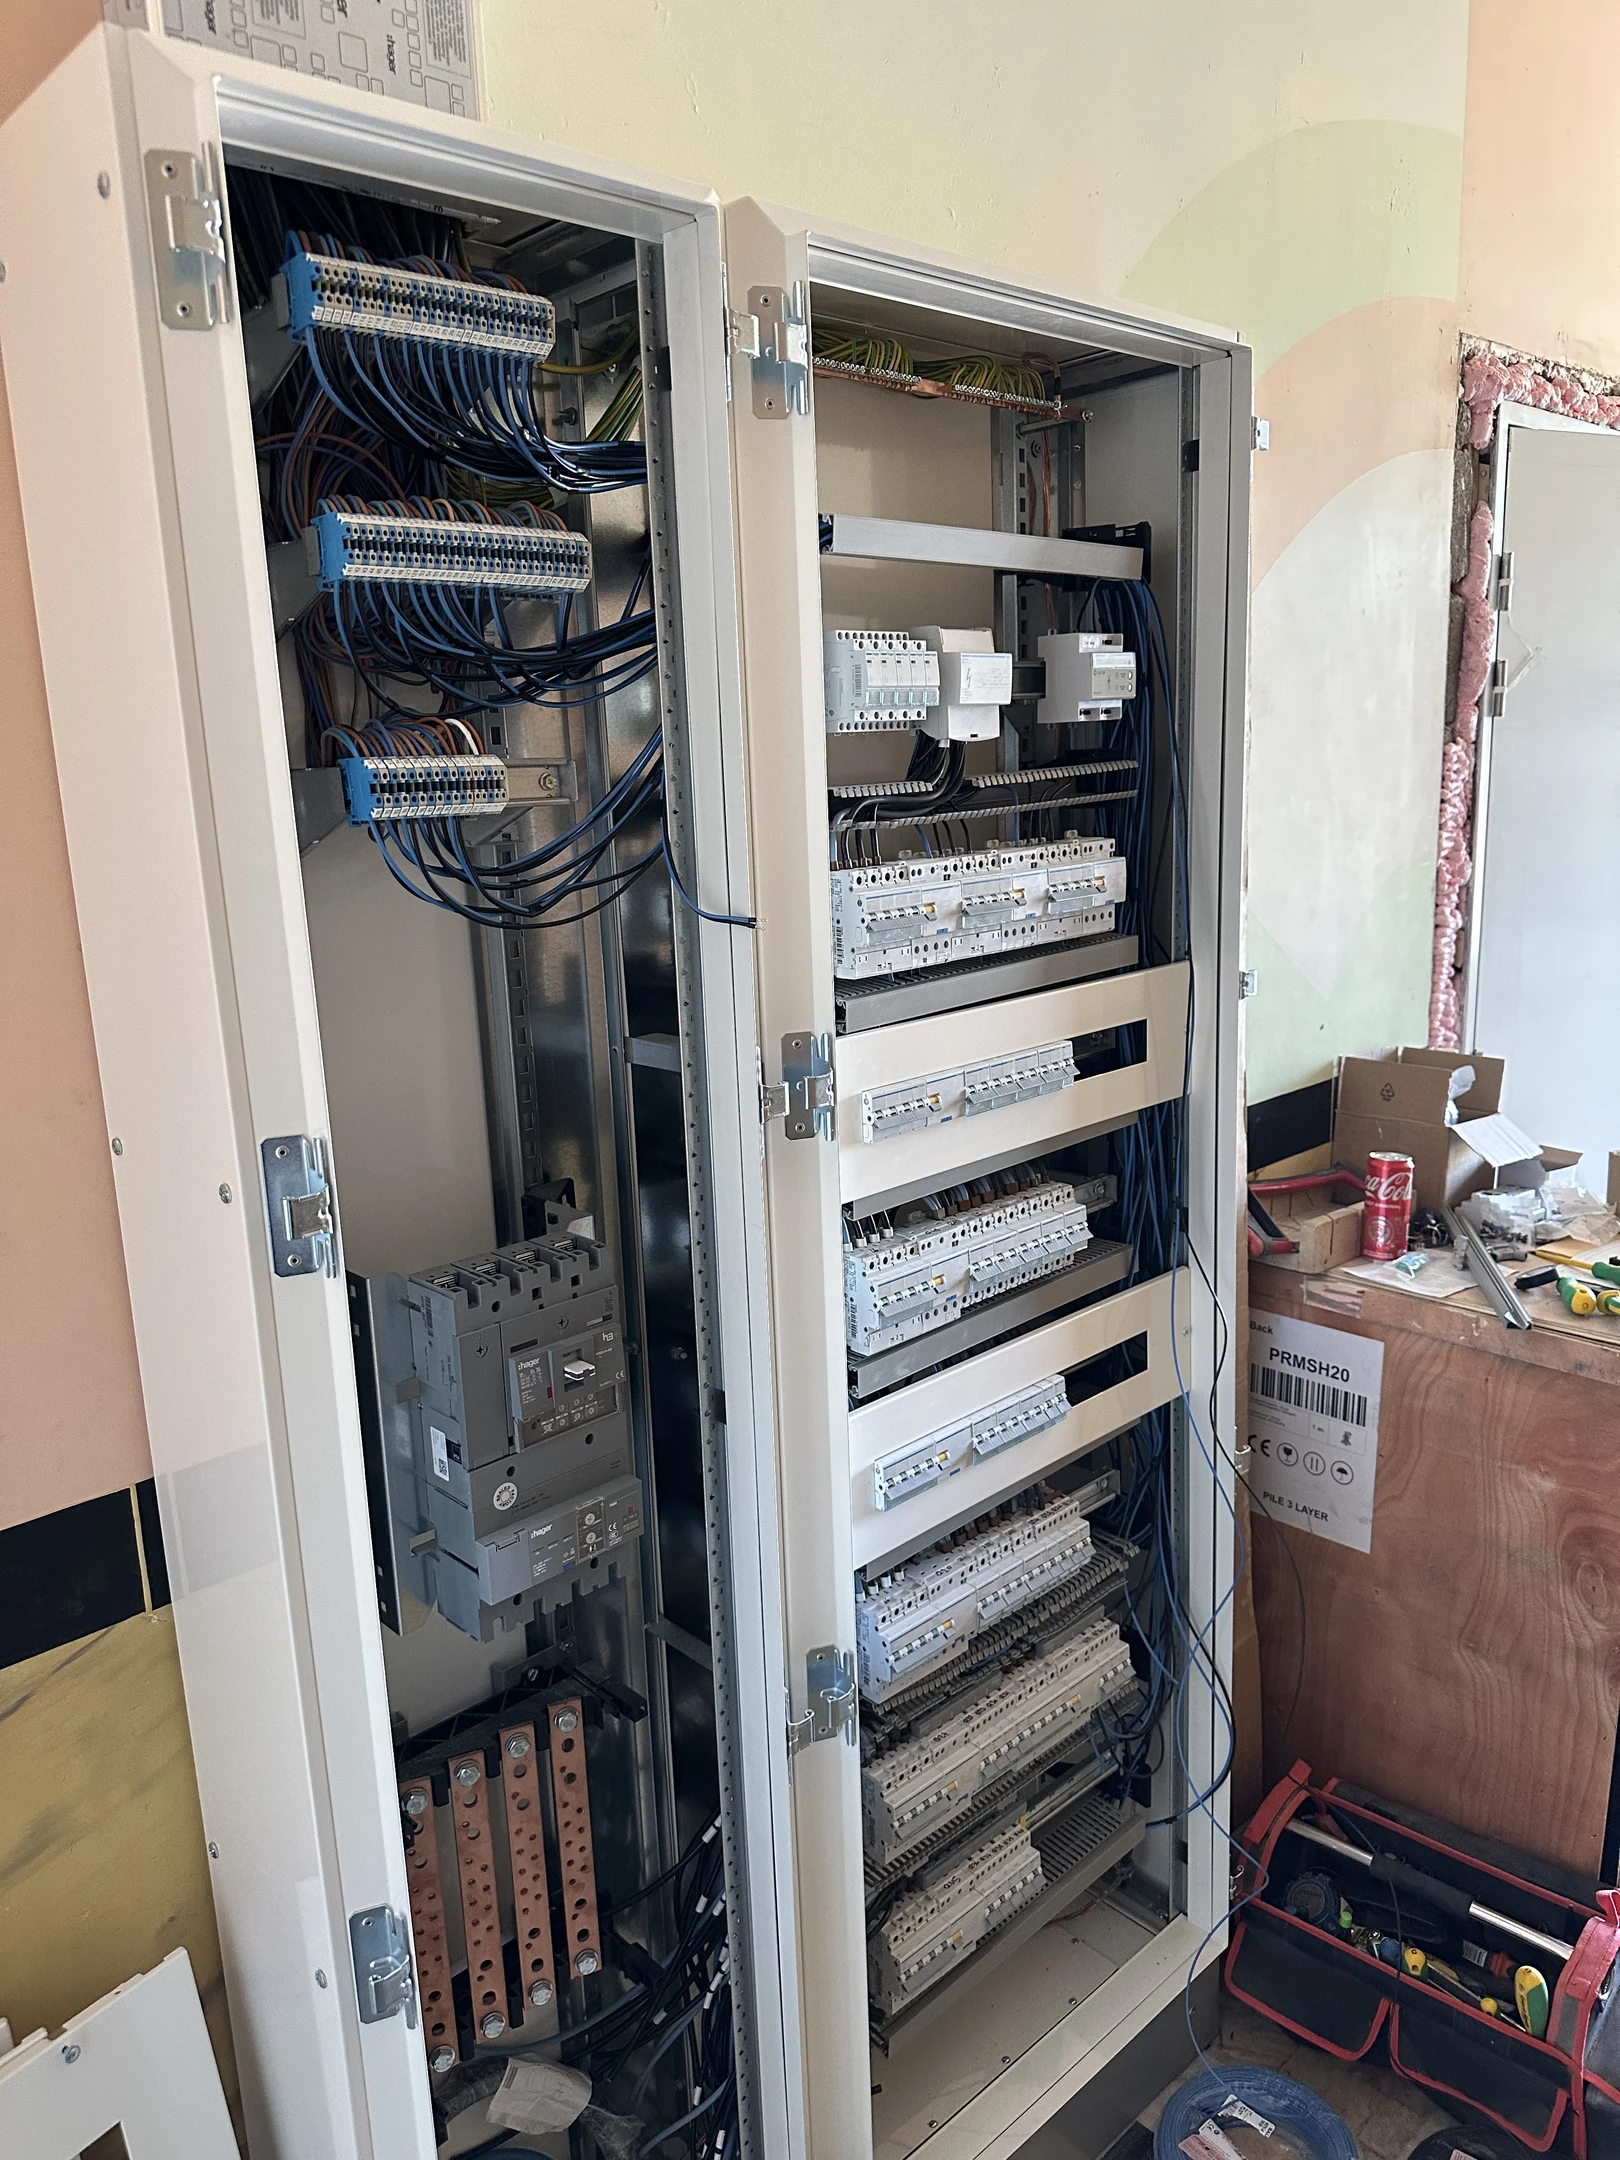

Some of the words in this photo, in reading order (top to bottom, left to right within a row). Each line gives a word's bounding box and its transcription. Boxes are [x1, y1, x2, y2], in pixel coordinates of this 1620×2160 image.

[1249, 1320, 1274, 1335] Back
[1268, 1346, 1351, 1384] PRMSH20
[1262, 1490, 1285, 1508] PILE
[1286, 1498, 1293, 1510] 3
[1294, 1501, 1329, 1523] LAYER
